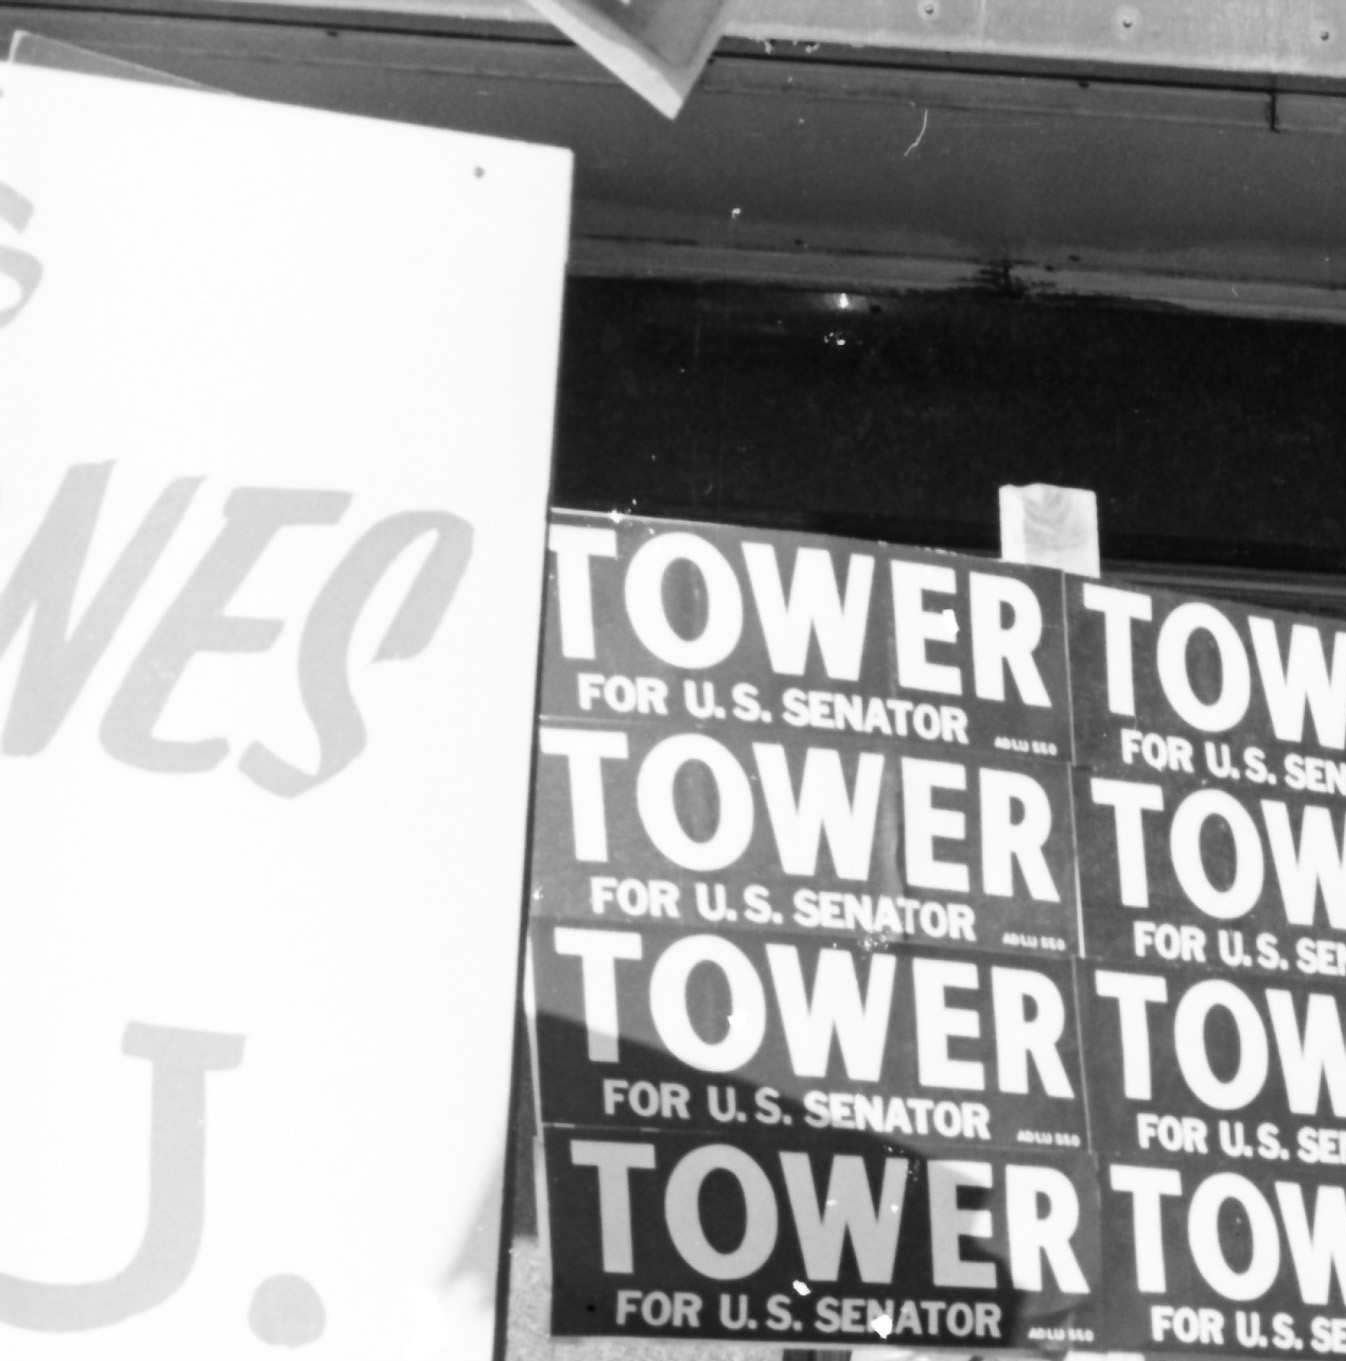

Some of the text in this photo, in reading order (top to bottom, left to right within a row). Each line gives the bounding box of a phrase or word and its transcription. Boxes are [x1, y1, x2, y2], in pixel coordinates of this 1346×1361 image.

[547, 523, 1052, 708] TOWER
[577, 672, 668, 715] FOR
[782, 687, 969, 744] SENATOR
[1121, 728, 1194, 773] FOR
[540, 726, 1060, 903] TOWER
[589, 876, 680, 919] FOR
[793, 889, 977, 942] SENATOR
[1133, 920, 1205, 963] FOR
[554, 926, 1075, 1100] TOWER
[602, 1078, 690, 1120] FOR
[804, 1090, 991, 1141] SENATOR
[1136, 1112, 1208, 1155] FOR
[570, 1139, 1090, 1295] TOWER
[616, 1290, 703, 1327] FOR
[815, 1296, 1002, 1339] SENATOR
[1150, 1305, 1223, 1346] FOR
